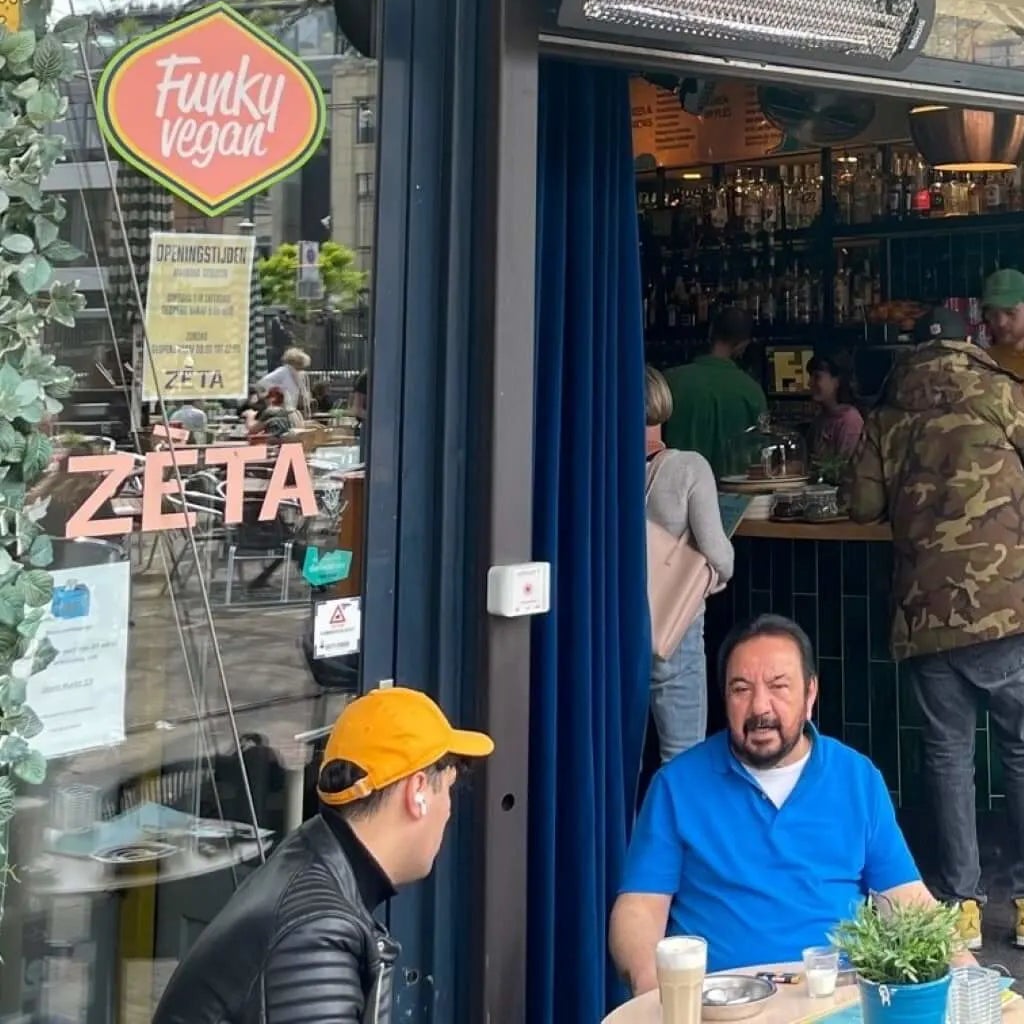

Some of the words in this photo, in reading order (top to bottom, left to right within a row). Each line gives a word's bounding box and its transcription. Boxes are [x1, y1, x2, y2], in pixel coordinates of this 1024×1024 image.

[156, 53, 286, 133] Funky
[161, 117, 268, 169] vegan
[156, 243, 248, 265] OPENINGSTIJDEN
